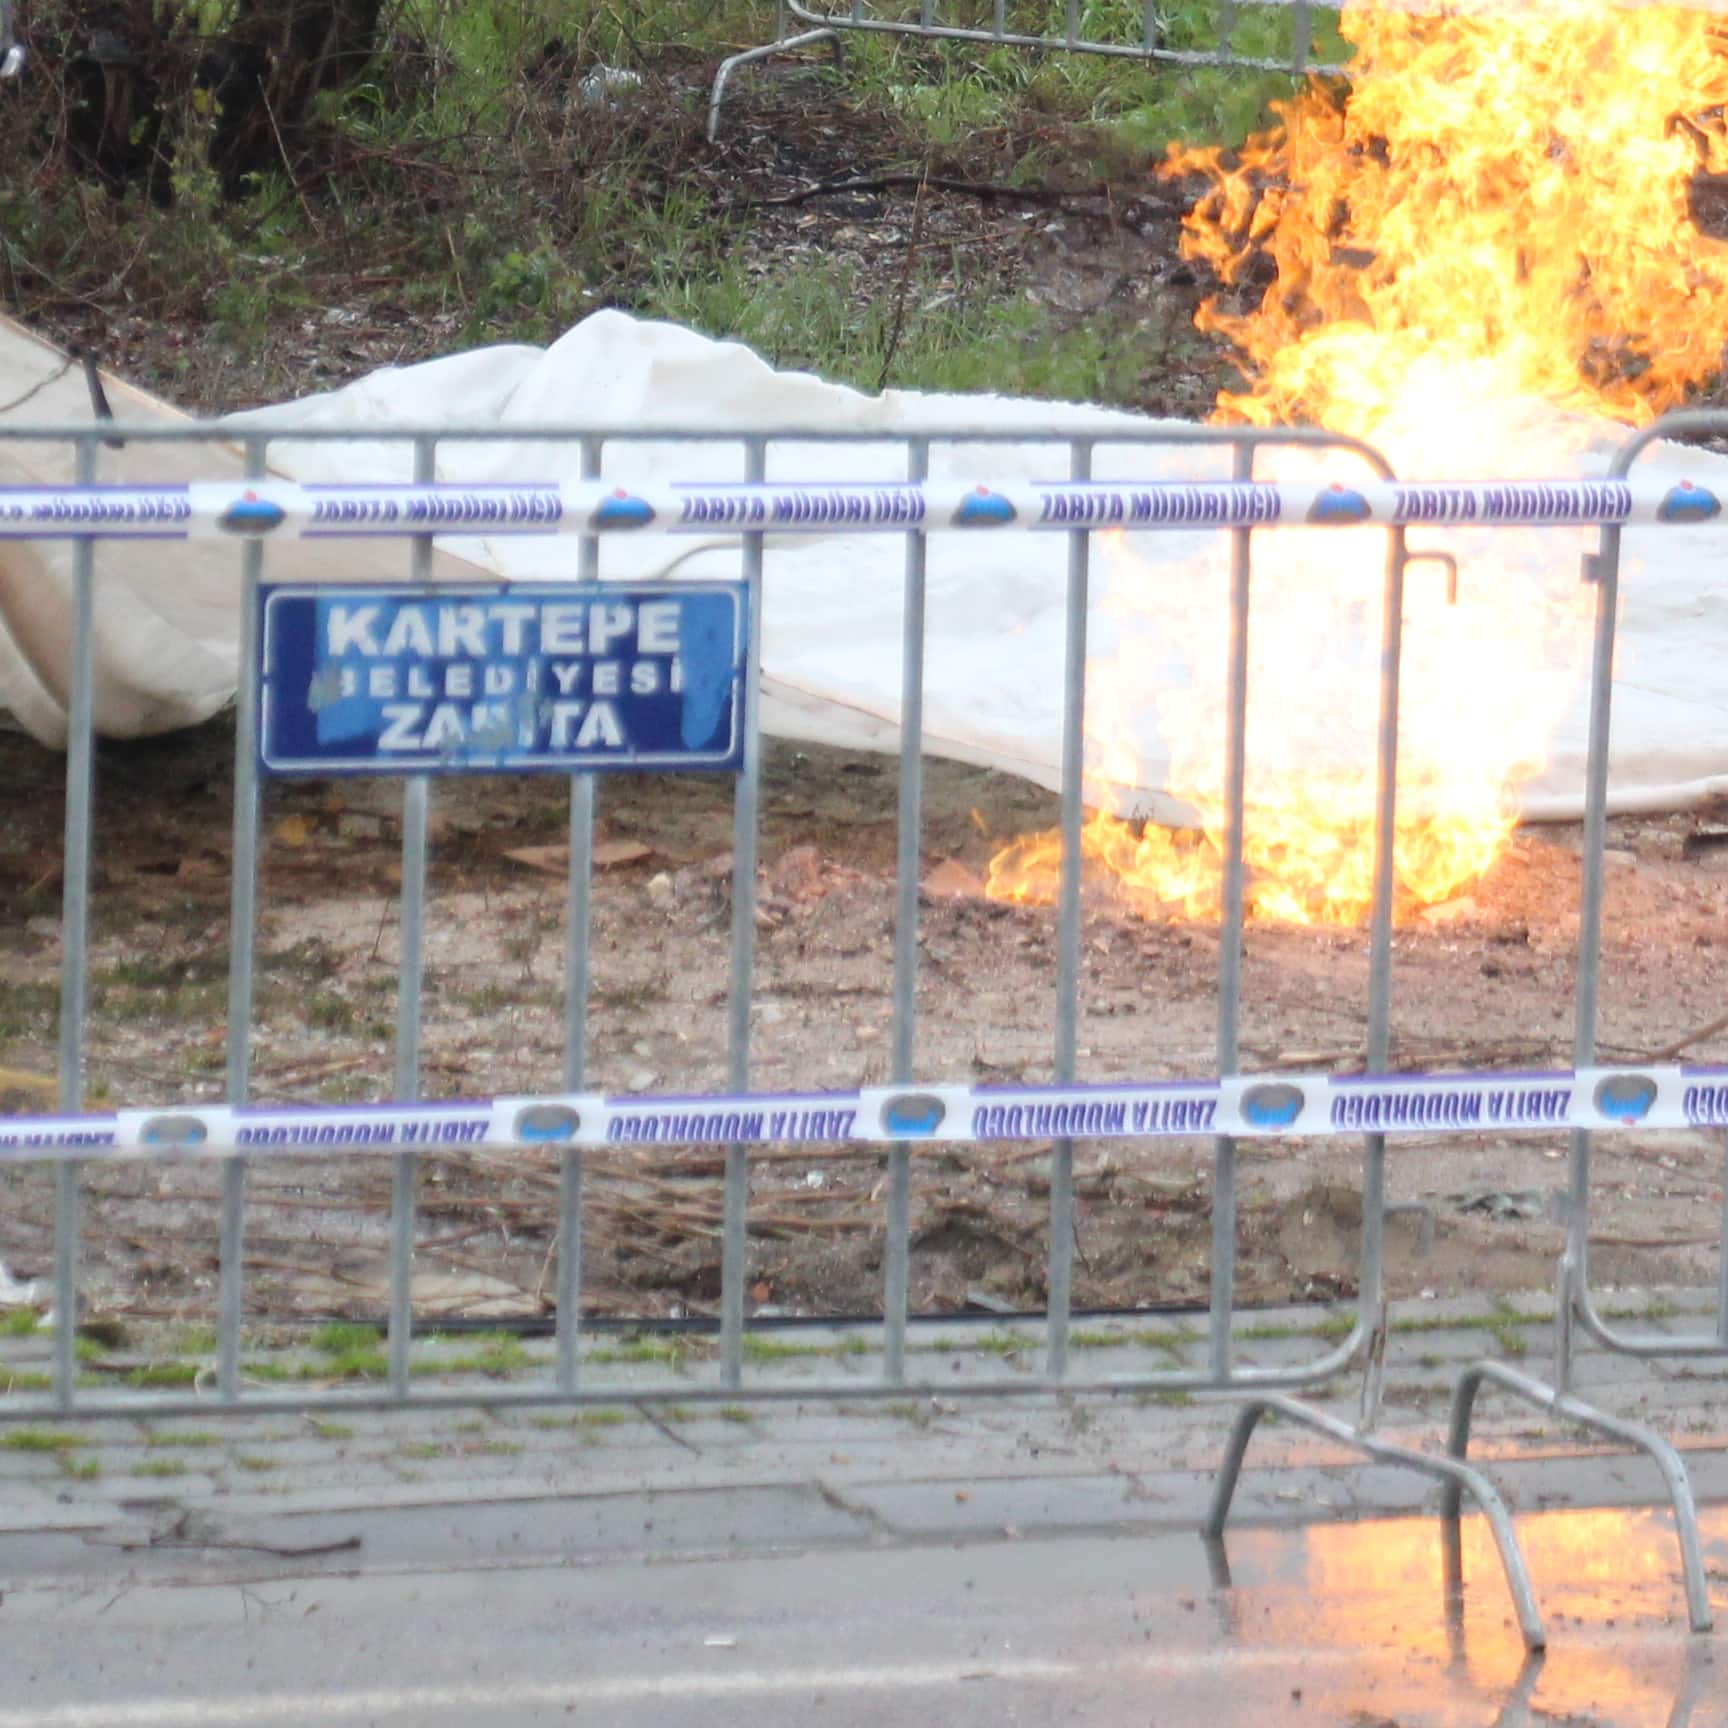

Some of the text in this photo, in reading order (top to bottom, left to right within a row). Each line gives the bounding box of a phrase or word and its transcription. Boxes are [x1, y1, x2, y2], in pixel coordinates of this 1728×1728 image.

[1039, 492, 1124, 523] ZABITA
[1394, 489, 1476, 522] ZABITA
[327, 601, 681, 657] KARTEPE
